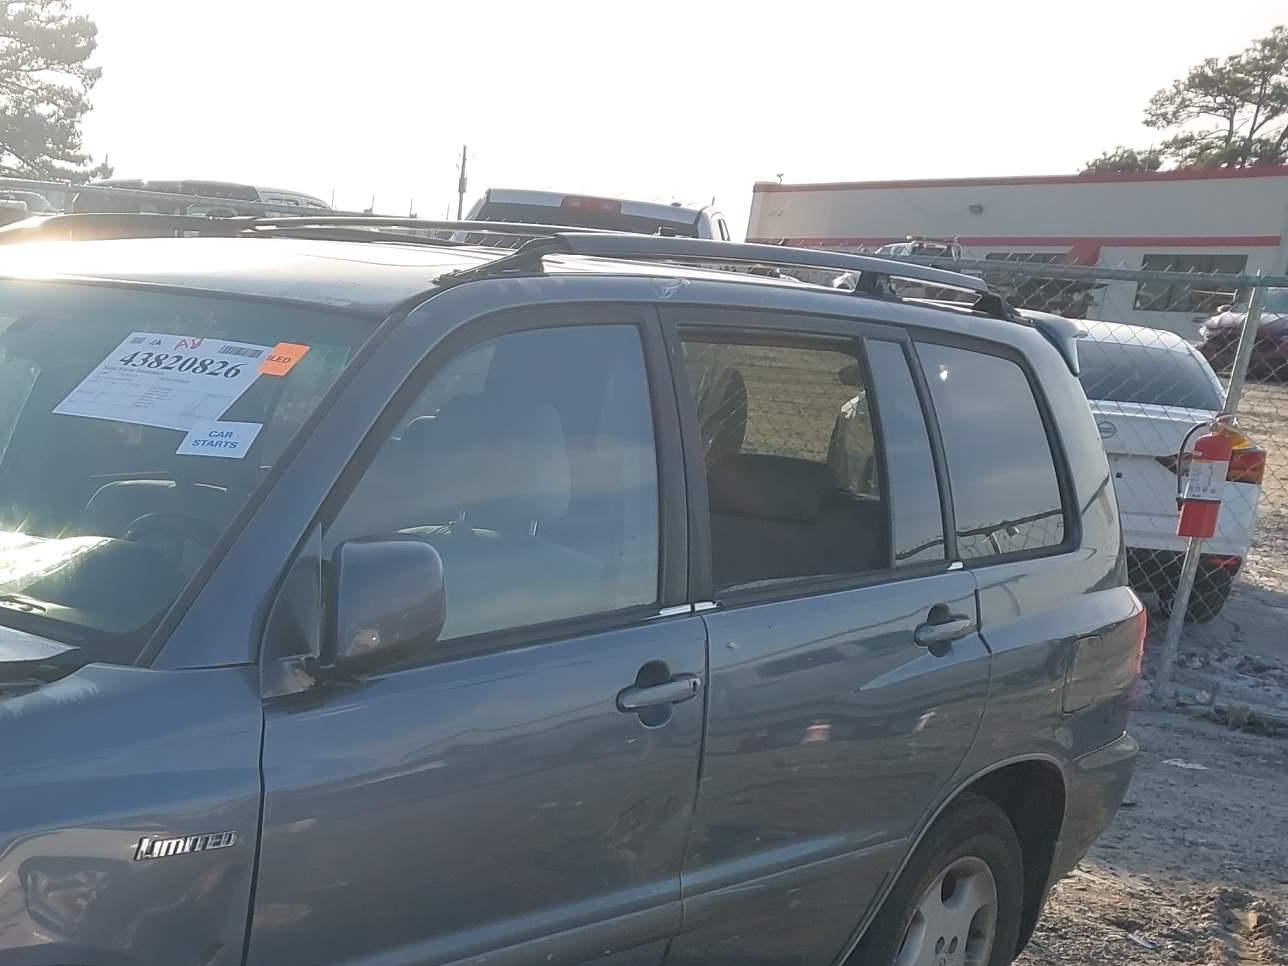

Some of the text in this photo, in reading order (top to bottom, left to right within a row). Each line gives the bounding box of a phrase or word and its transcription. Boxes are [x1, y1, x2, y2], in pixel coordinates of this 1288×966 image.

[119, 350, 248, 379] 43820826
[208, 430, 234, 439] CAR
[191, 439, 239, 449] STARTS
